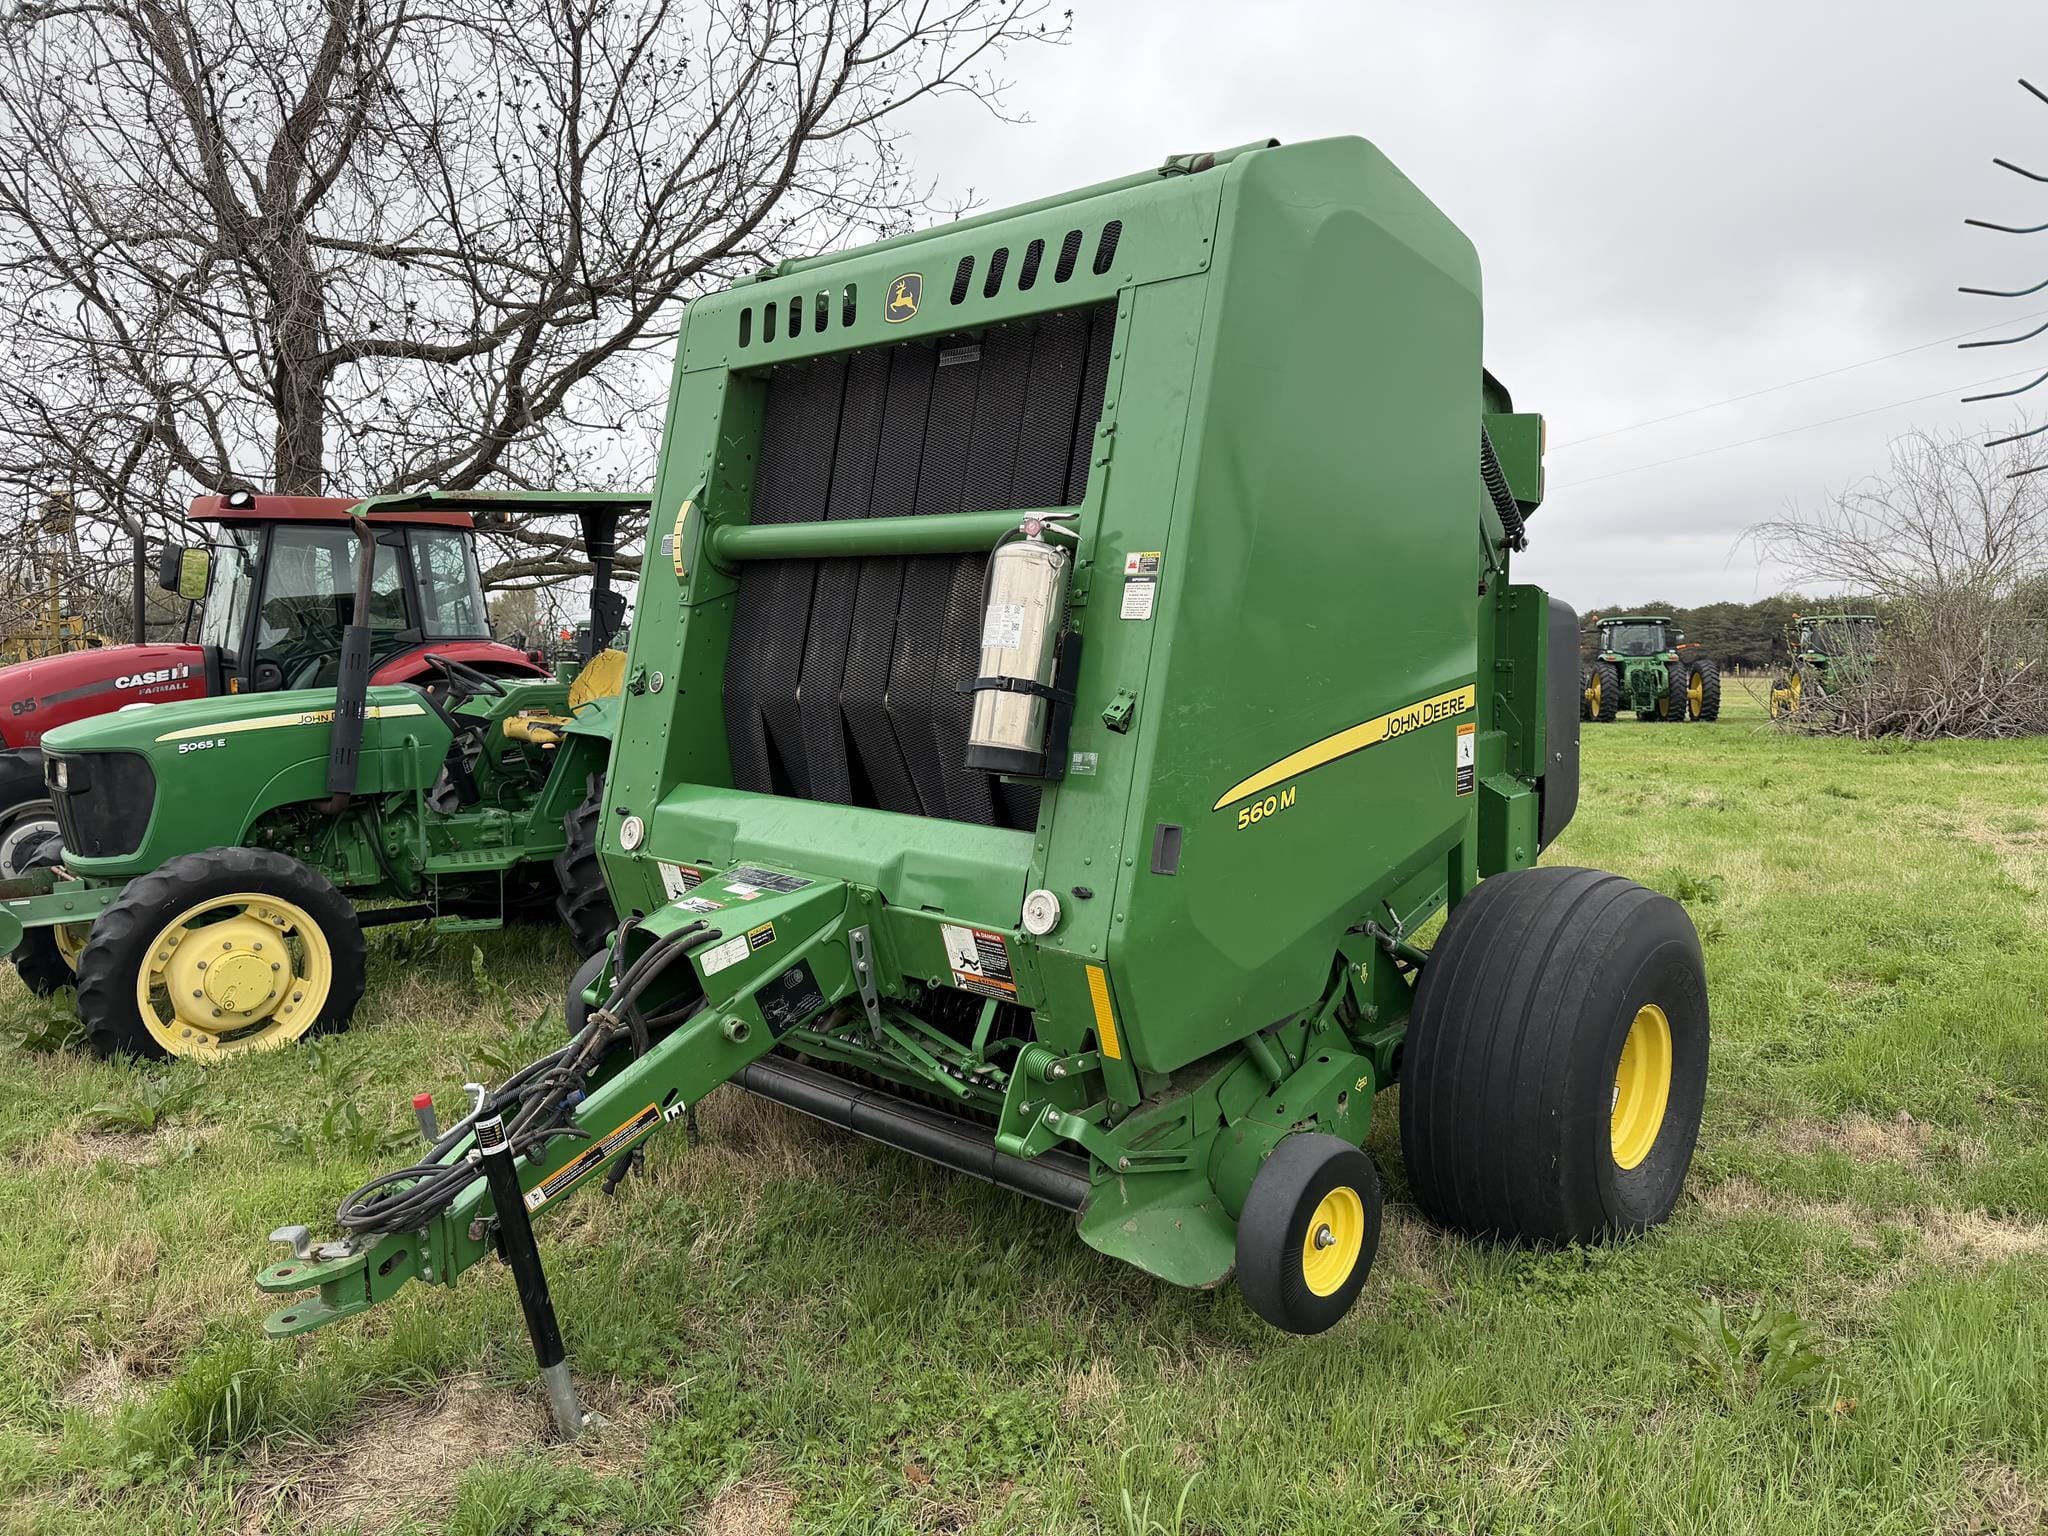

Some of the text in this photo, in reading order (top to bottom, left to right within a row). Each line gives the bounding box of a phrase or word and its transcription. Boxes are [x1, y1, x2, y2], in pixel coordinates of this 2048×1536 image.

[115, 663, 189, 689] CASE IH
[138, 683, 189, 695] FARMALL
[11, 697, 37, 716] 95
[298, 714, 329, 724] JOHN
[1382, 695, 1465, 740] JOHN DEERE
[178, 738, 226, 754] 5065 E
[1237, 786, 1296, 830] 560 M
